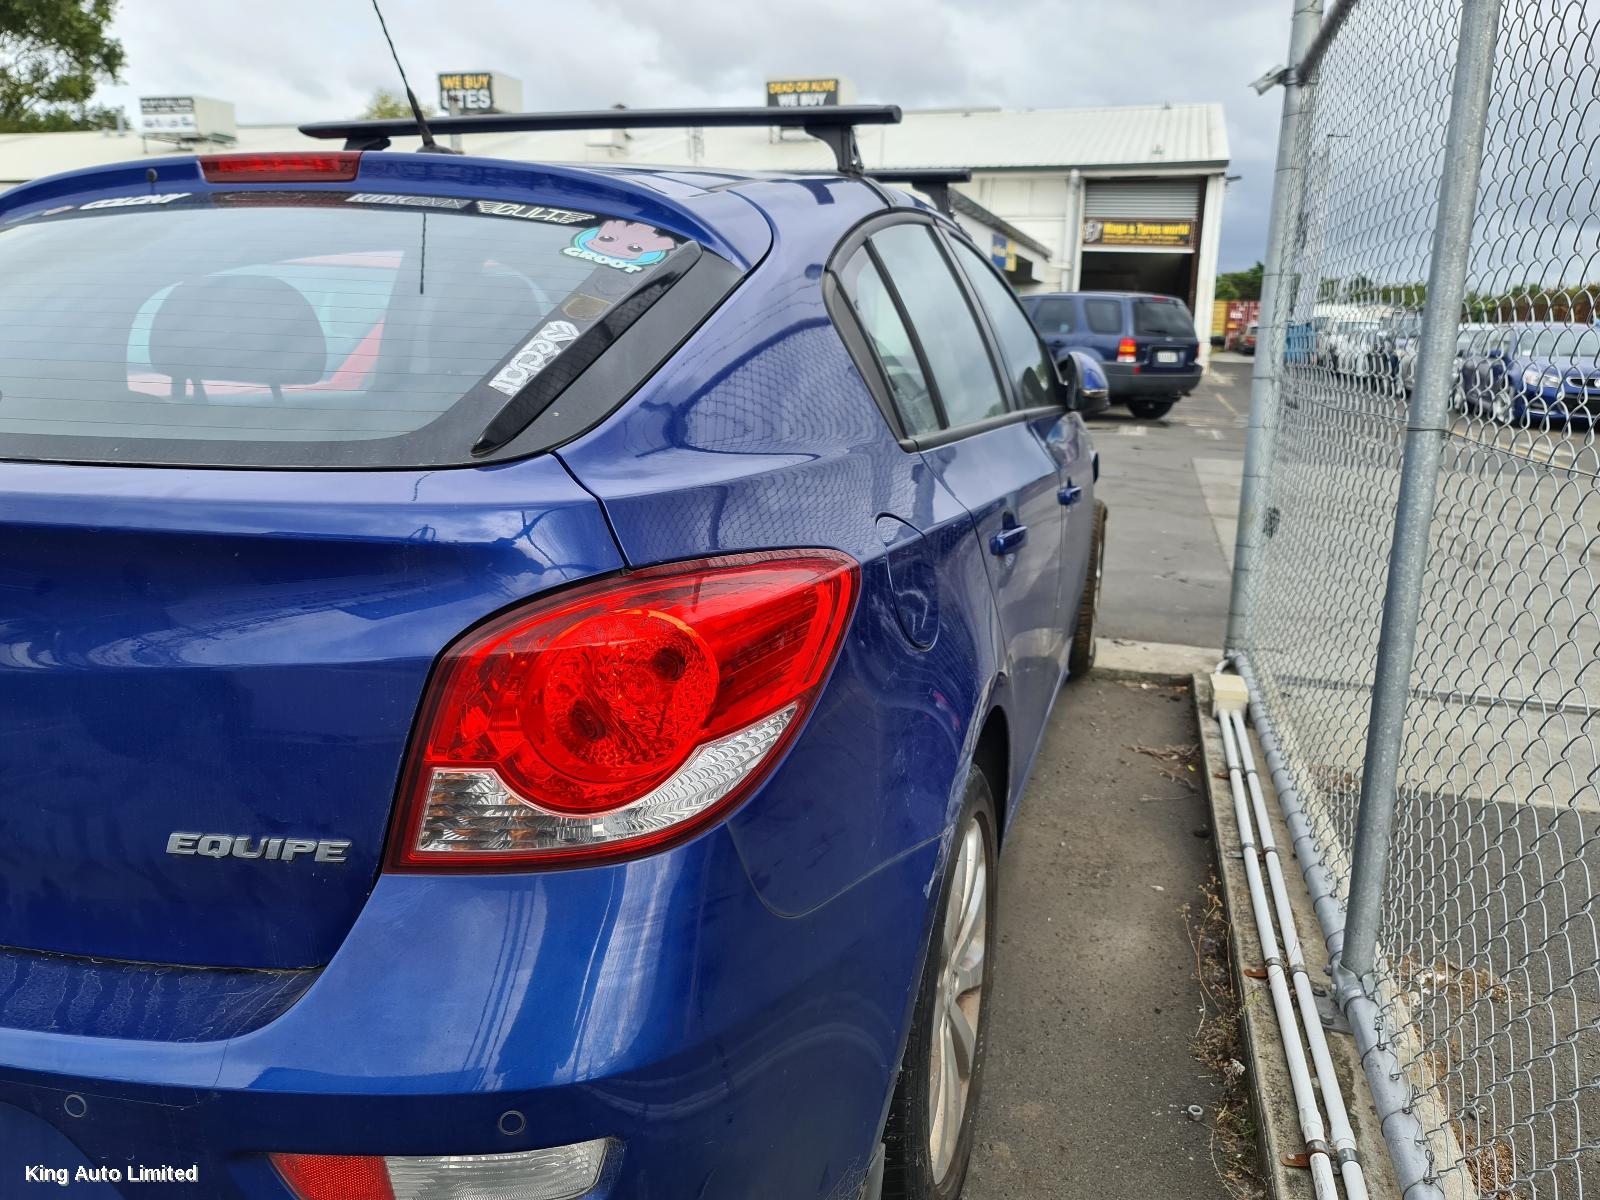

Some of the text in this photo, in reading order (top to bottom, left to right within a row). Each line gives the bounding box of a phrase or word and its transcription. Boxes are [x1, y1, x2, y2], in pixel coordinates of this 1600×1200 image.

[442, 73, 489, 89] WE BUY
[777, 92, 827, 106] WE BUY
[562, 247, 643, 274] GROOT
[166, 832, 352, 863] EQUIPE
